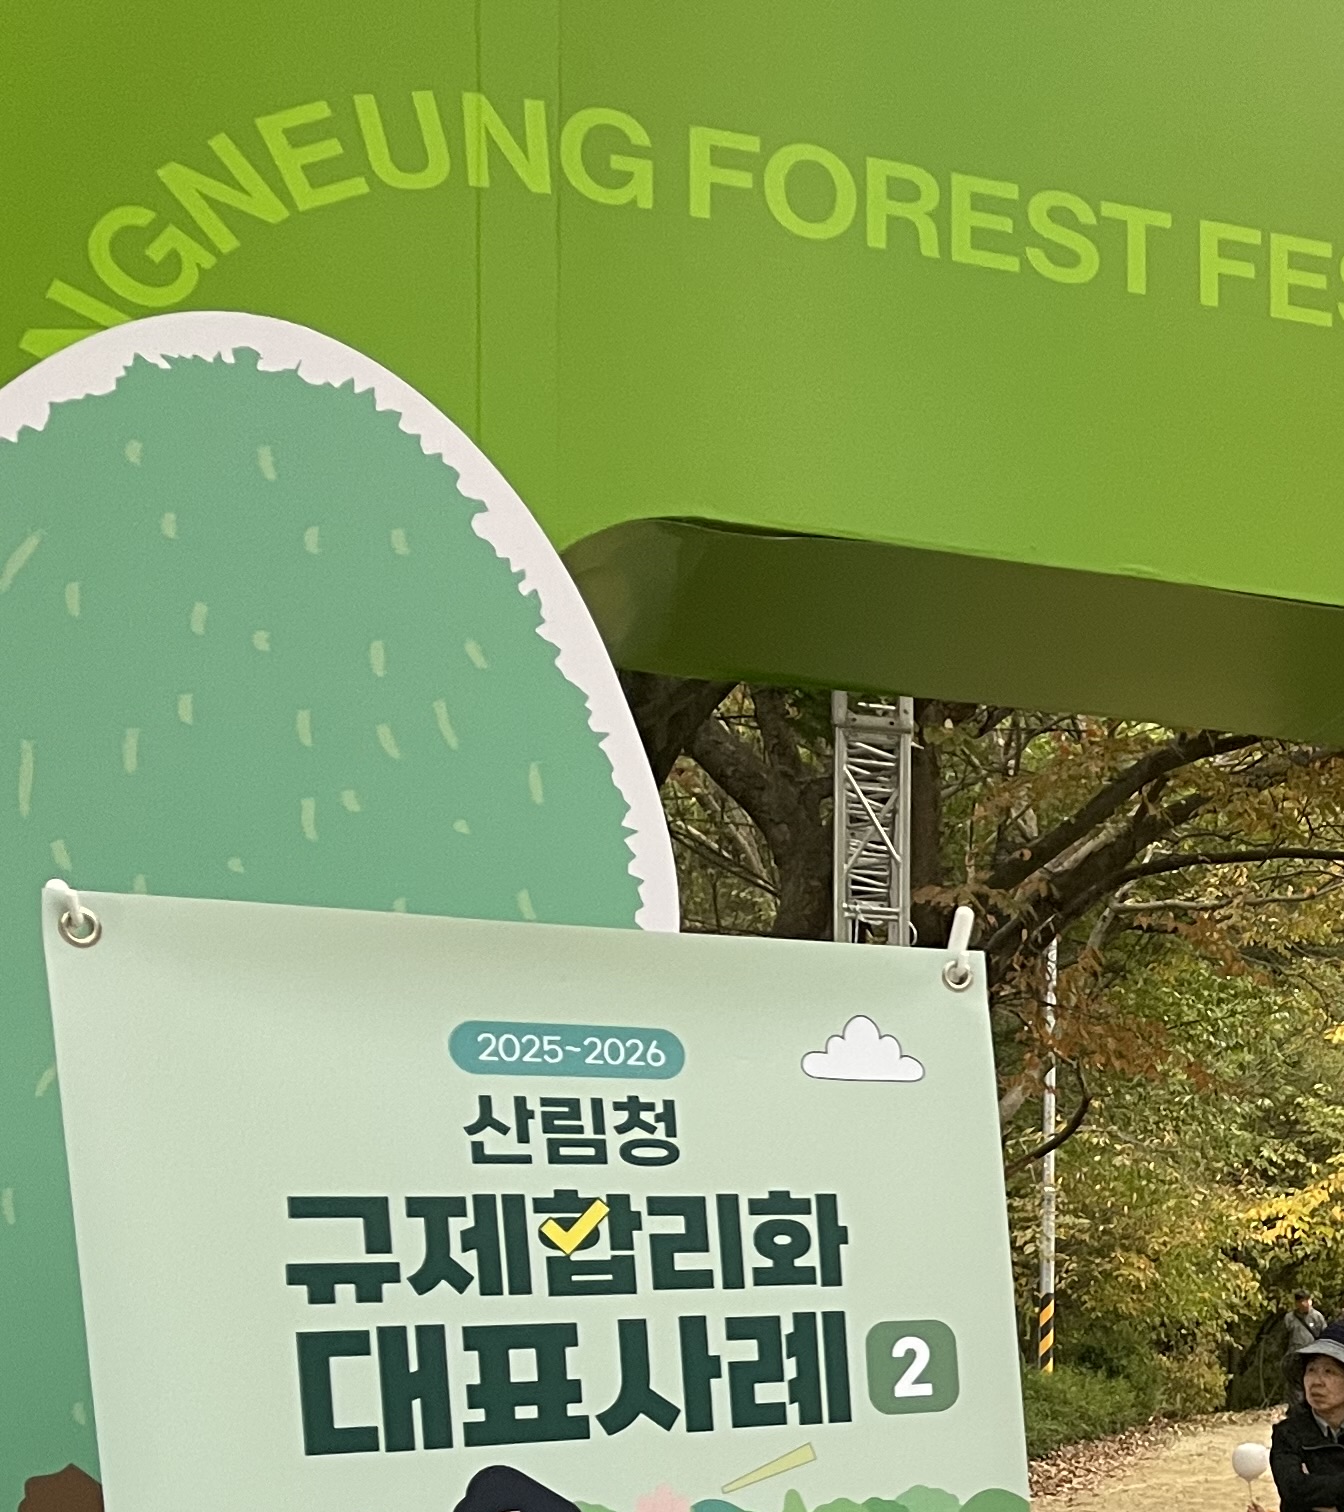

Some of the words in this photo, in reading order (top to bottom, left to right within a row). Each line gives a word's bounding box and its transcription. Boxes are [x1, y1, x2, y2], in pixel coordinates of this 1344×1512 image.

[689, 125, 1173, 296] FOREST
[476, 1033, 667, 1068] 2025~2026
[463, 1094, 681, 1168] 산림청
[285, 1189, 849, 1305] 규제합리화
[295, 1310, 853, 1456] 대표사례
[890, 1336, 934, 1398] 2
